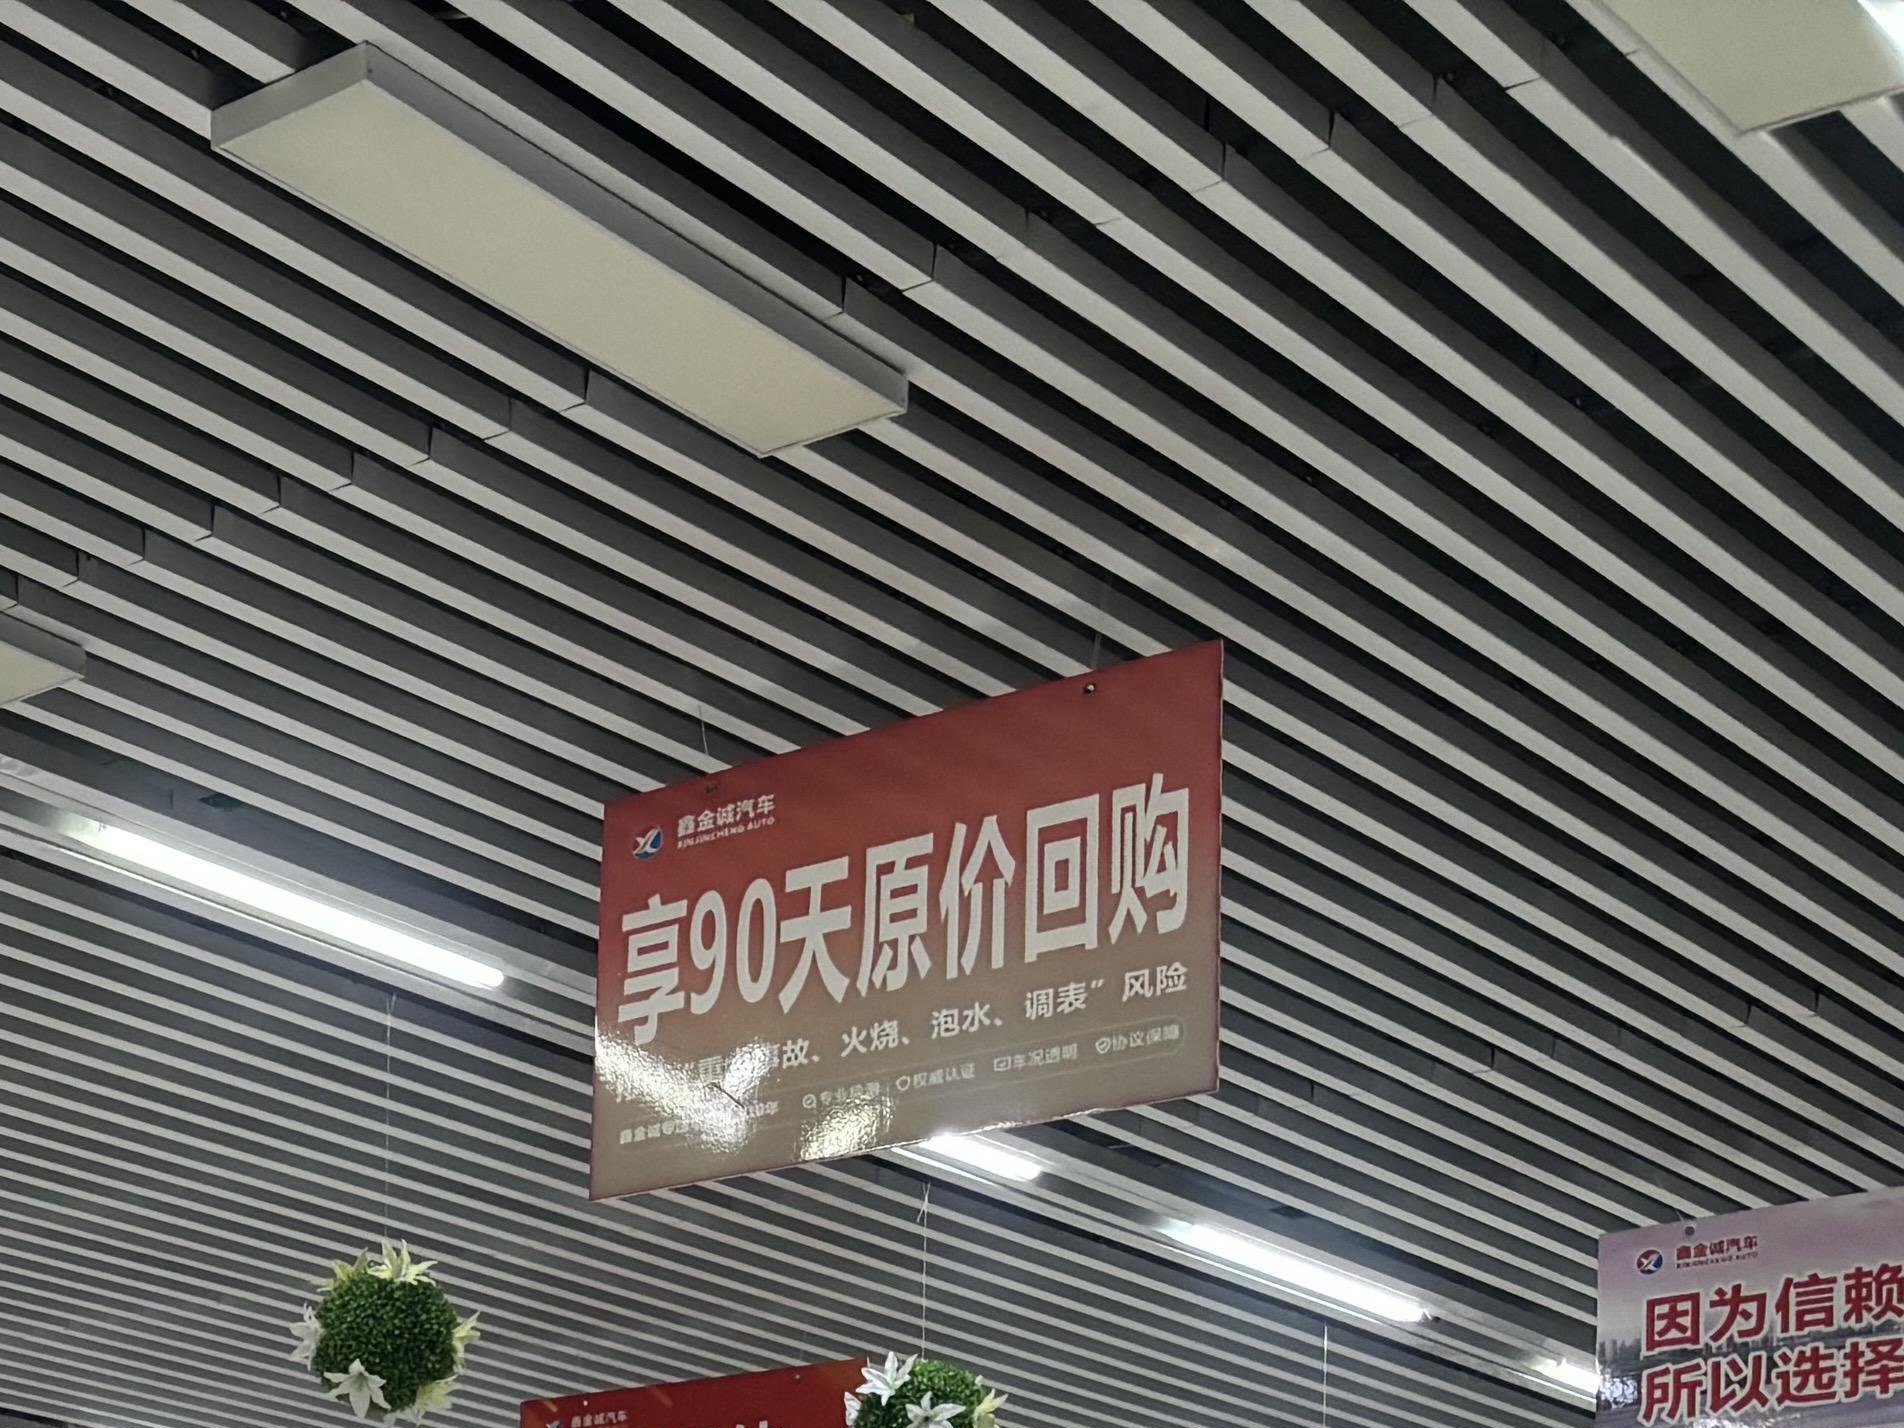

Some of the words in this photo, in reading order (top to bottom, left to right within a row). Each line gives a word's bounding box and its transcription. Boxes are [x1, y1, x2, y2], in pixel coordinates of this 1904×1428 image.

[677, 793, 775, 838] 鑫金诚汽车
[618, 773, 1191, 1046] 享90天原价回购
[1645, 1264, 1904, 1352] 因为信赖
[1642, 1337, 1904, 1423] 所以选择
